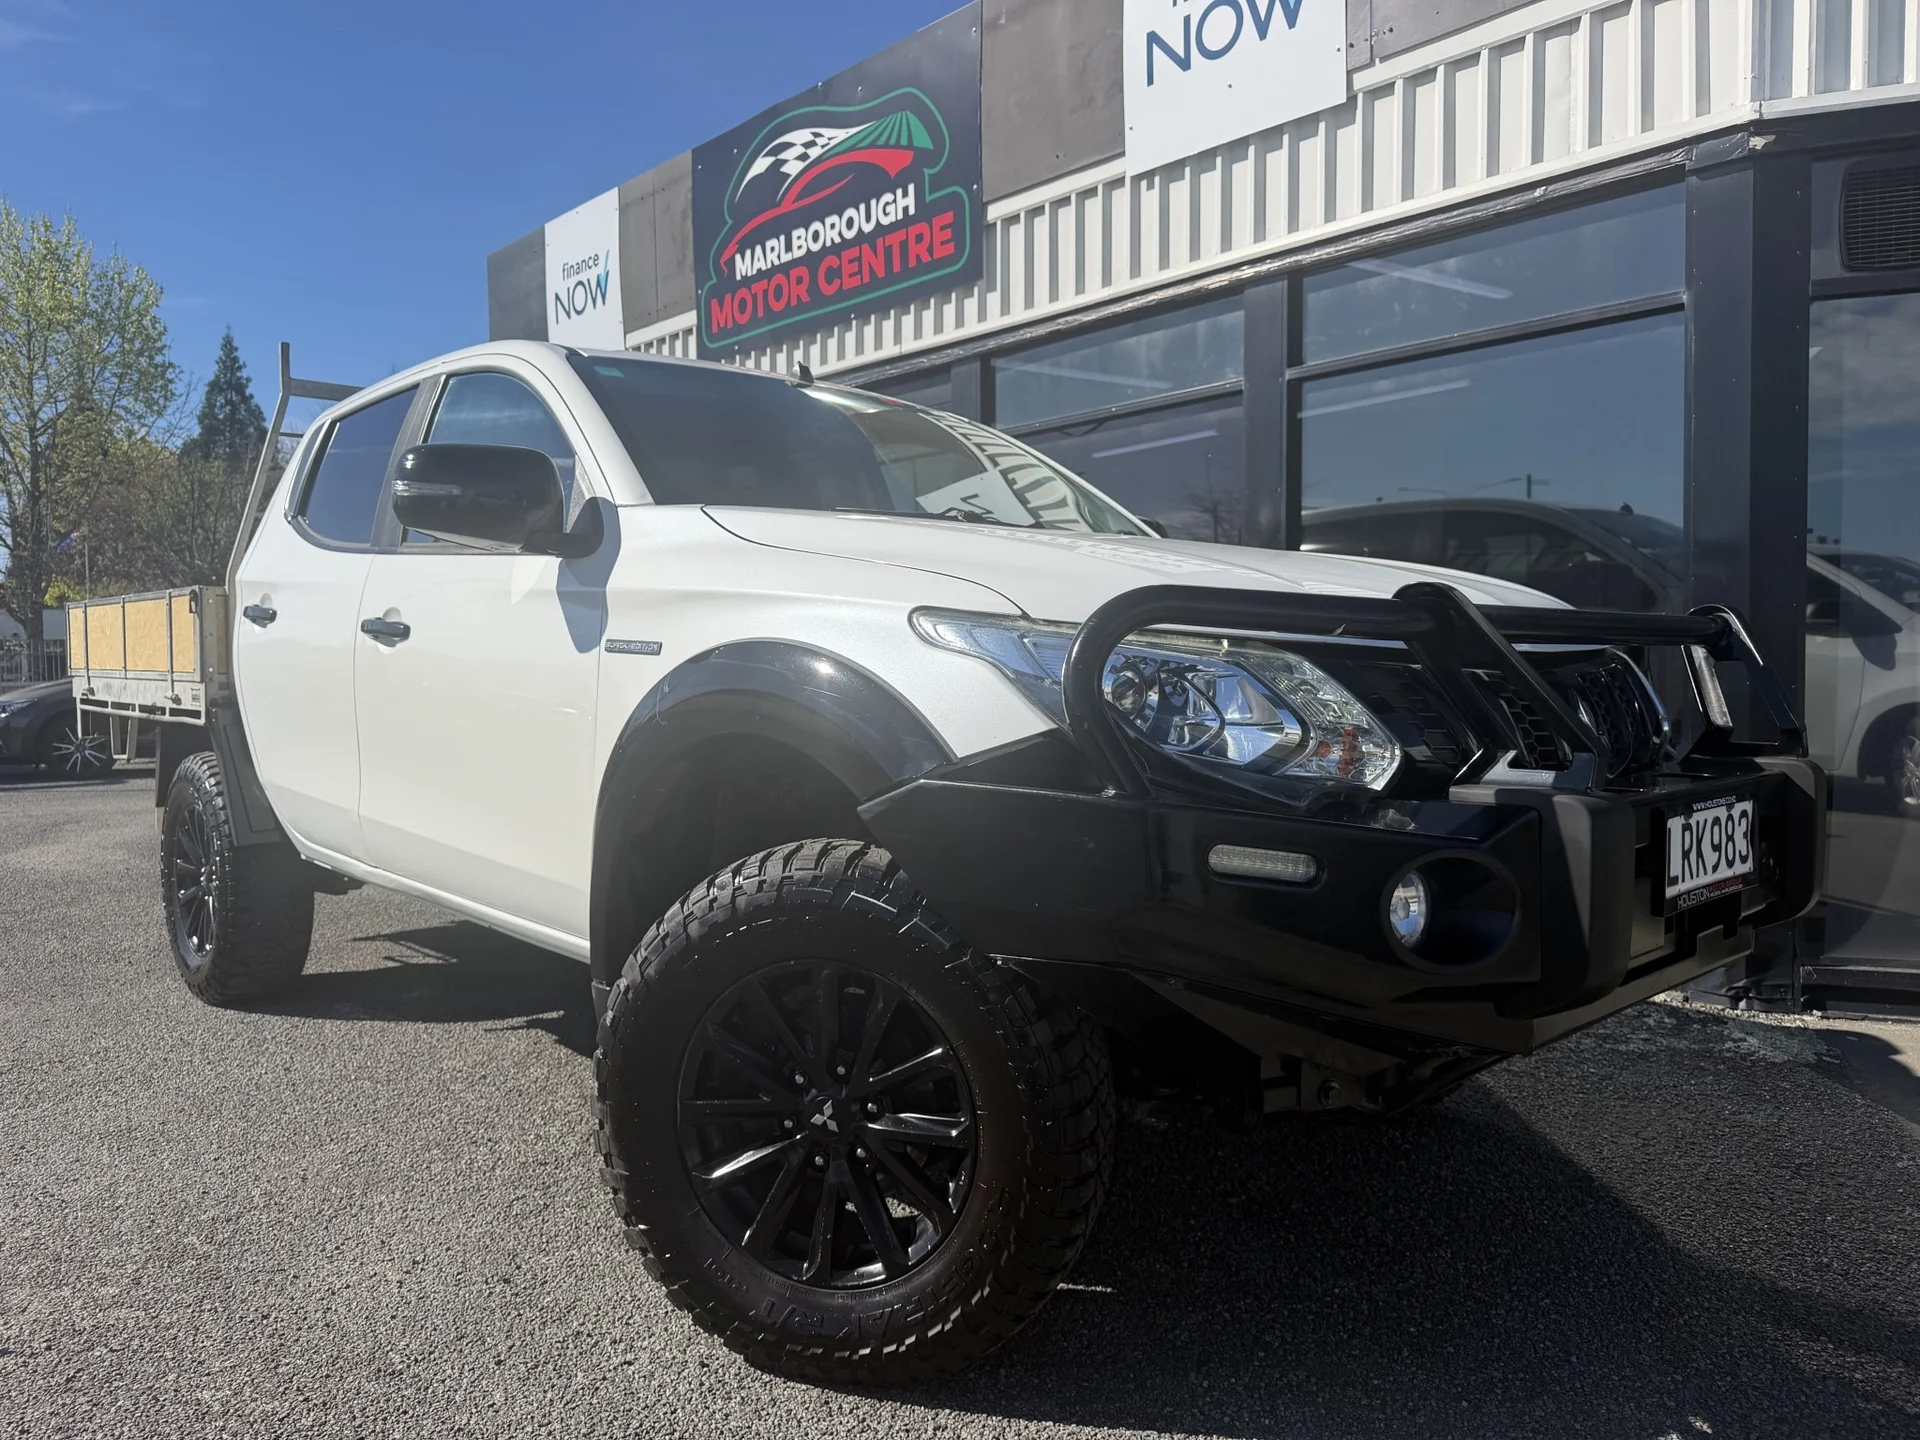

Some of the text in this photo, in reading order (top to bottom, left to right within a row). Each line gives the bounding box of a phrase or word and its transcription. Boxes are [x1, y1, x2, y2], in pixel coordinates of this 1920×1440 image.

[1146, 0, 1303, 87] NOW
[562, 253, 600, 281] finance
[734, 183, 915, 281] MARLBOROUGH
[555, 269, 610, 325] NOW
[711, 211, 955, 334] MOTOR CENTRE
[1667, 809, 1750, 888] LRK983
[1677, 886, 1711, 909] HOUSTON
